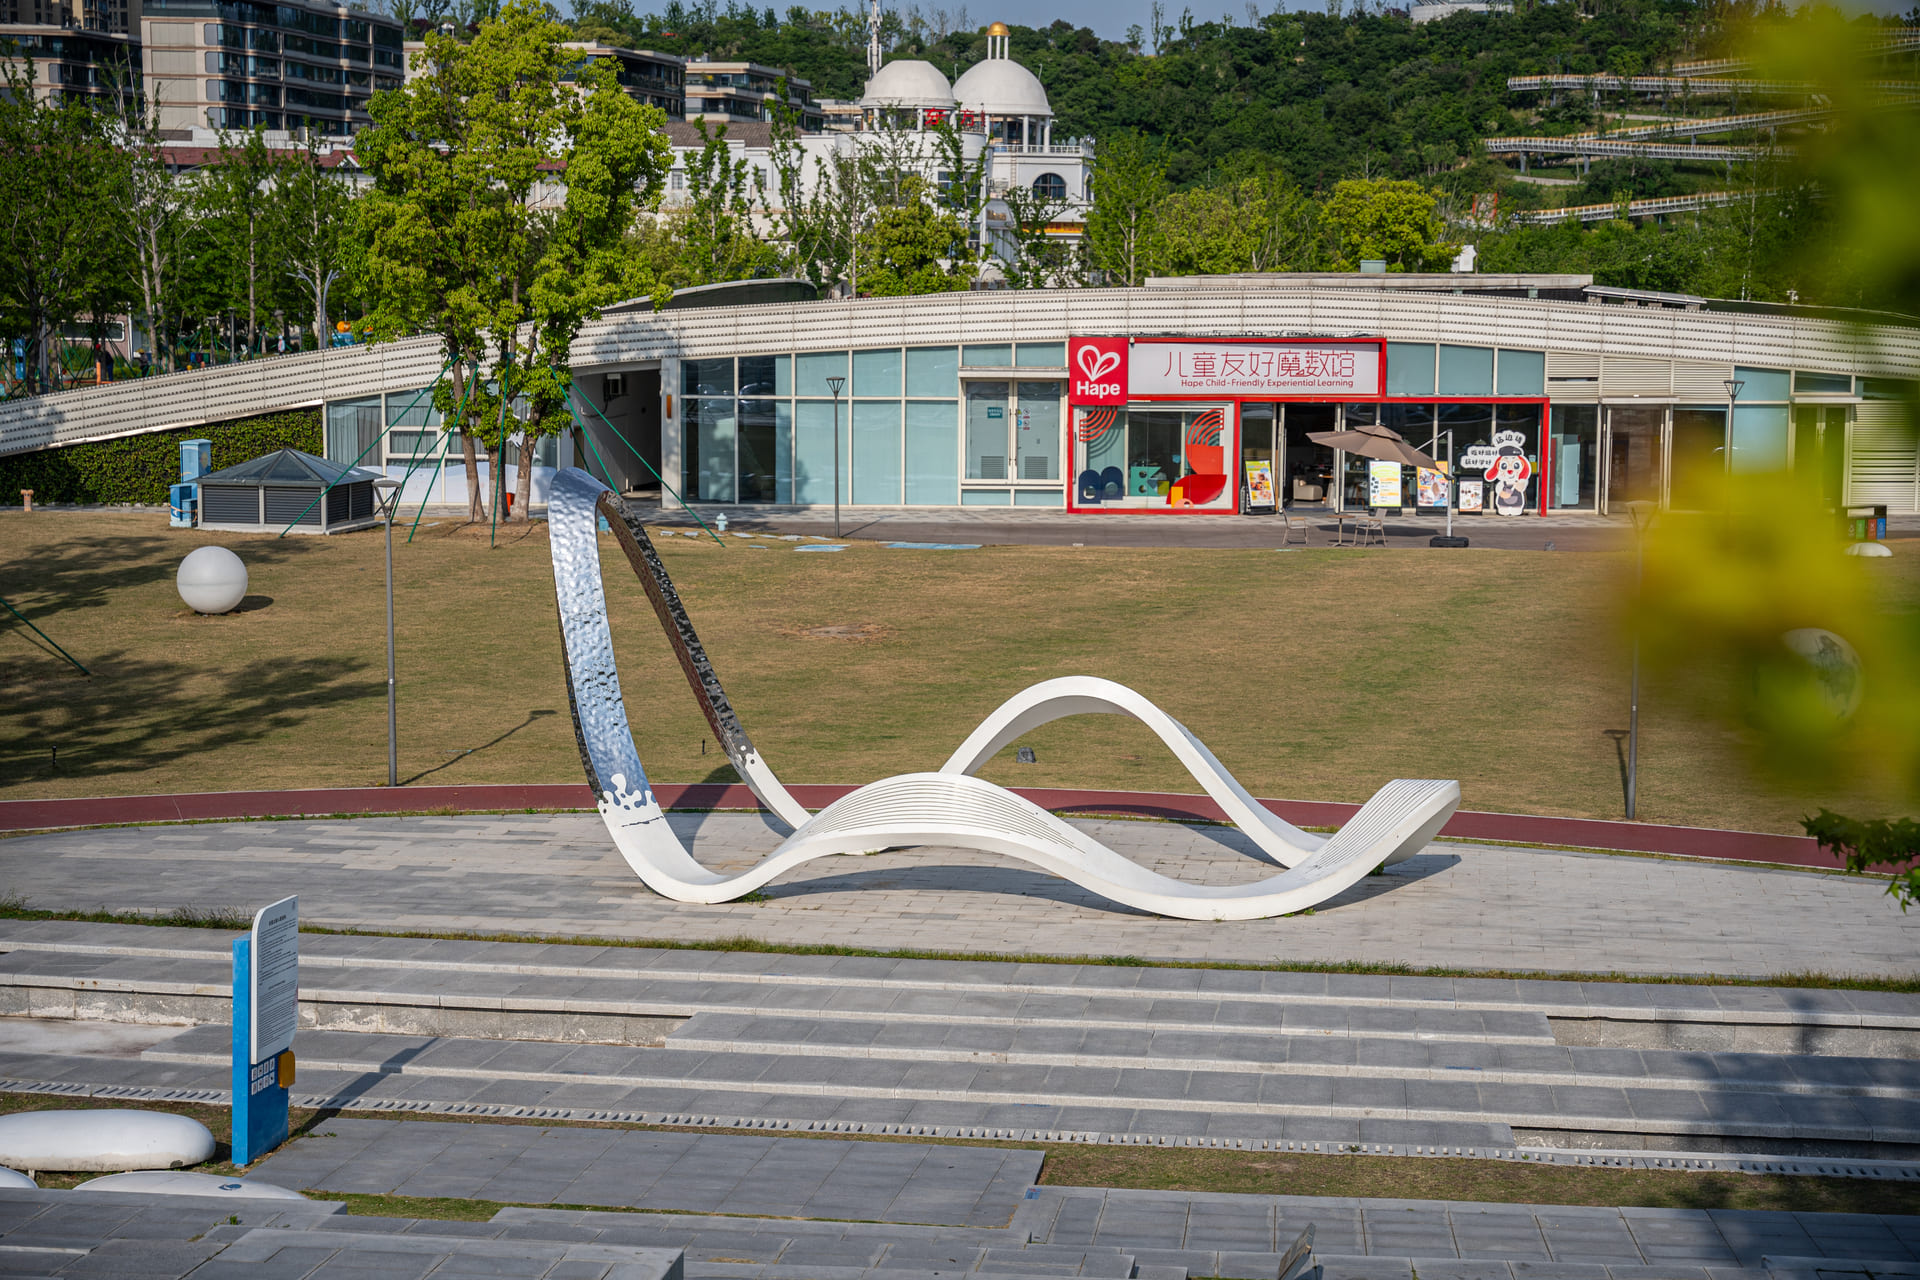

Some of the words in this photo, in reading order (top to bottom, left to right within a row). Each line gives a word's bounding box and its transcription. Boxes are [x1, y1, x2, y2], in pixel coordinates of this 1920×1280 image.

[924, 107, 986, 127] 东方
[1076, 380, 1121, 399] Hape
[1181, 379, 1204, 388] Hape
[1267, 379, 1316, 388] Experiential
[1317, 379, 1354, 388] Learning
